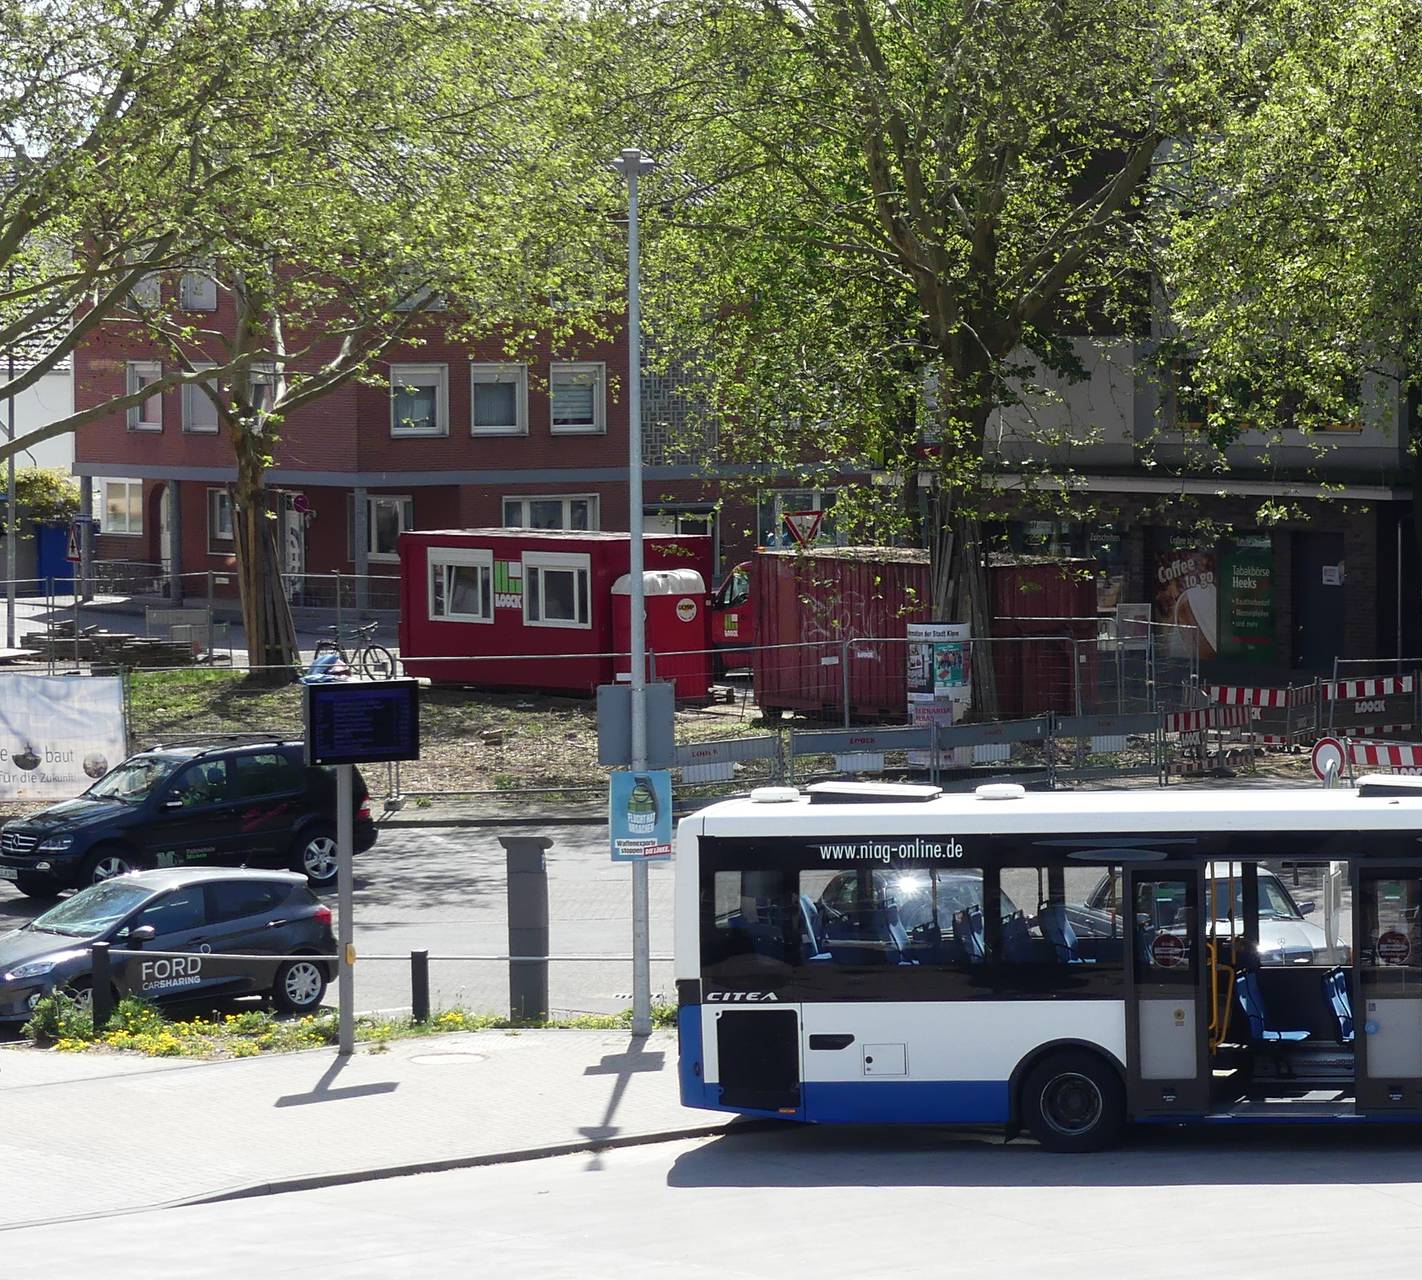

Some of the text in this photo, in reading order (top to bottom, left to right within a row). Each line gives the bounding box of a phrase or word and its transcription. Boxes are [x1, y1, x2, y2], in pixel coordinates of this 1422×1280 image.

[1158, 559, 1195, 583] Coffee
[1232, 565, 1270, 576] Tabakbörse
[1184, 571, 1214, 589] to go
[1232, 577, 1257, 589] Heeks
[495, 593, 522, 608] LOOCK
[1355, 700, 1386, 714] LOOCK
[46, 745, 74, 764] baut
[20, 772, 37, 783] die
[820, 837, 963, 863] www.niag-online.de
[142, 956, 202, 981] FORD
[142, 975, 201, 991] CARSHARING
[706, 991, 778, 1001] CITEA
